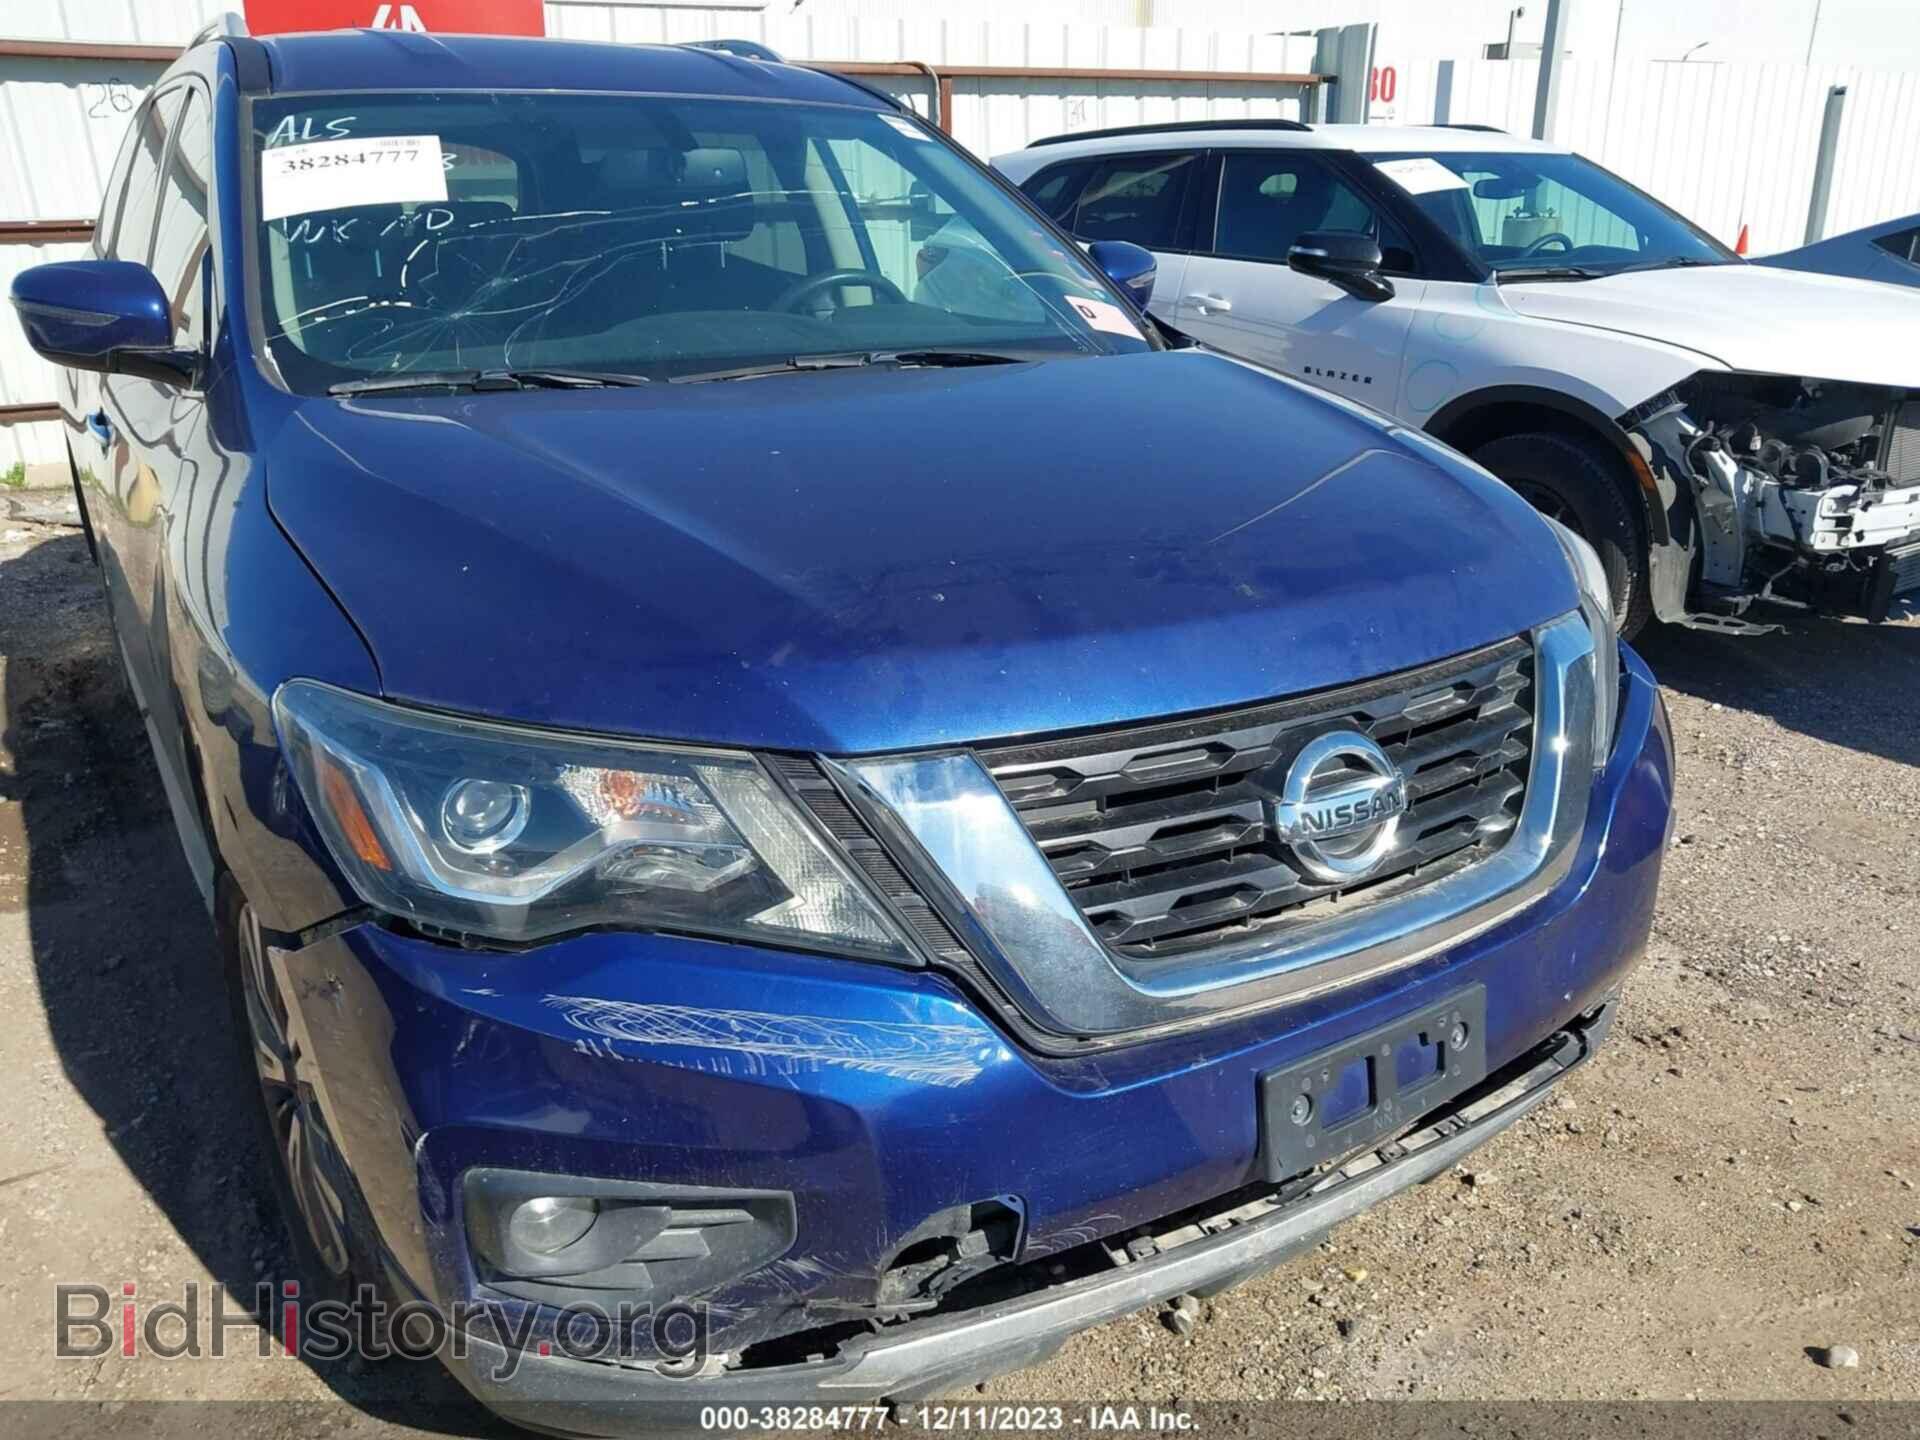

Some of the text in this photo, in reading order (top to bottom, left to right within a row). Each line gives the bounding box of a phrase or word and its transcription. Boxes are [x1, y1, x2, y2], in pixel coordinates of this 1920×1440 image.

[281, 150, 419, 173] 38284777
[1303, 365, 1373, 385] BLAZER
[1299, 786, 1404, 833] NISSAN
